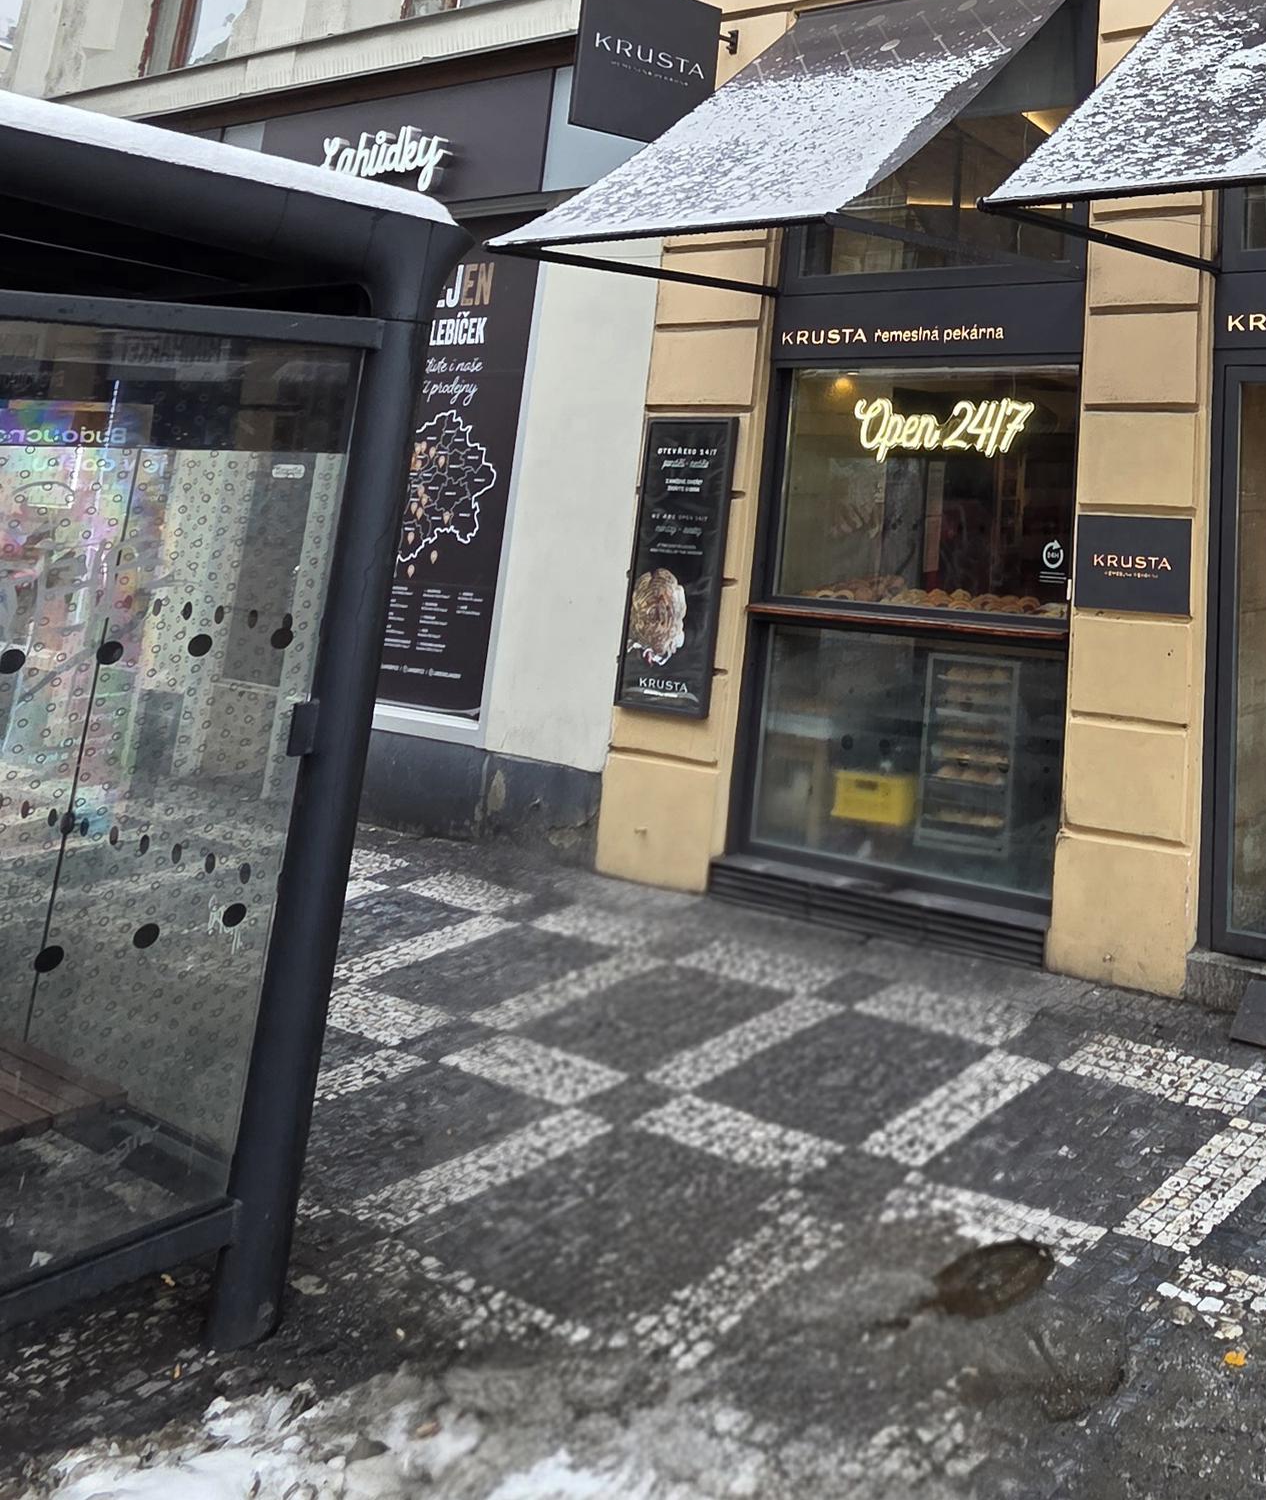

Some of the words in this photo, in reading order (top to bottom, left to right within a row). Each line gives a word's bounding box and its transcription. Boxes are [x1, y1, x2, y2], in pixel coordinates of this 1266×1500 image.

[595, 32, 705, 80] KRUSTA
[782, 327, 867, 345] KRUSTA
[874, 325, 940, 343] řemeslná
[943, 324, 1004, 343] pekárna
[427, 375, 479, 407] prodejny
[854, 397, 941, 463] Open
[943, 398, 1035, 458] 24/7
[1093, 554, 1172, 571] KRUSTA
[639, 677, 688, 694] KRUSTA
